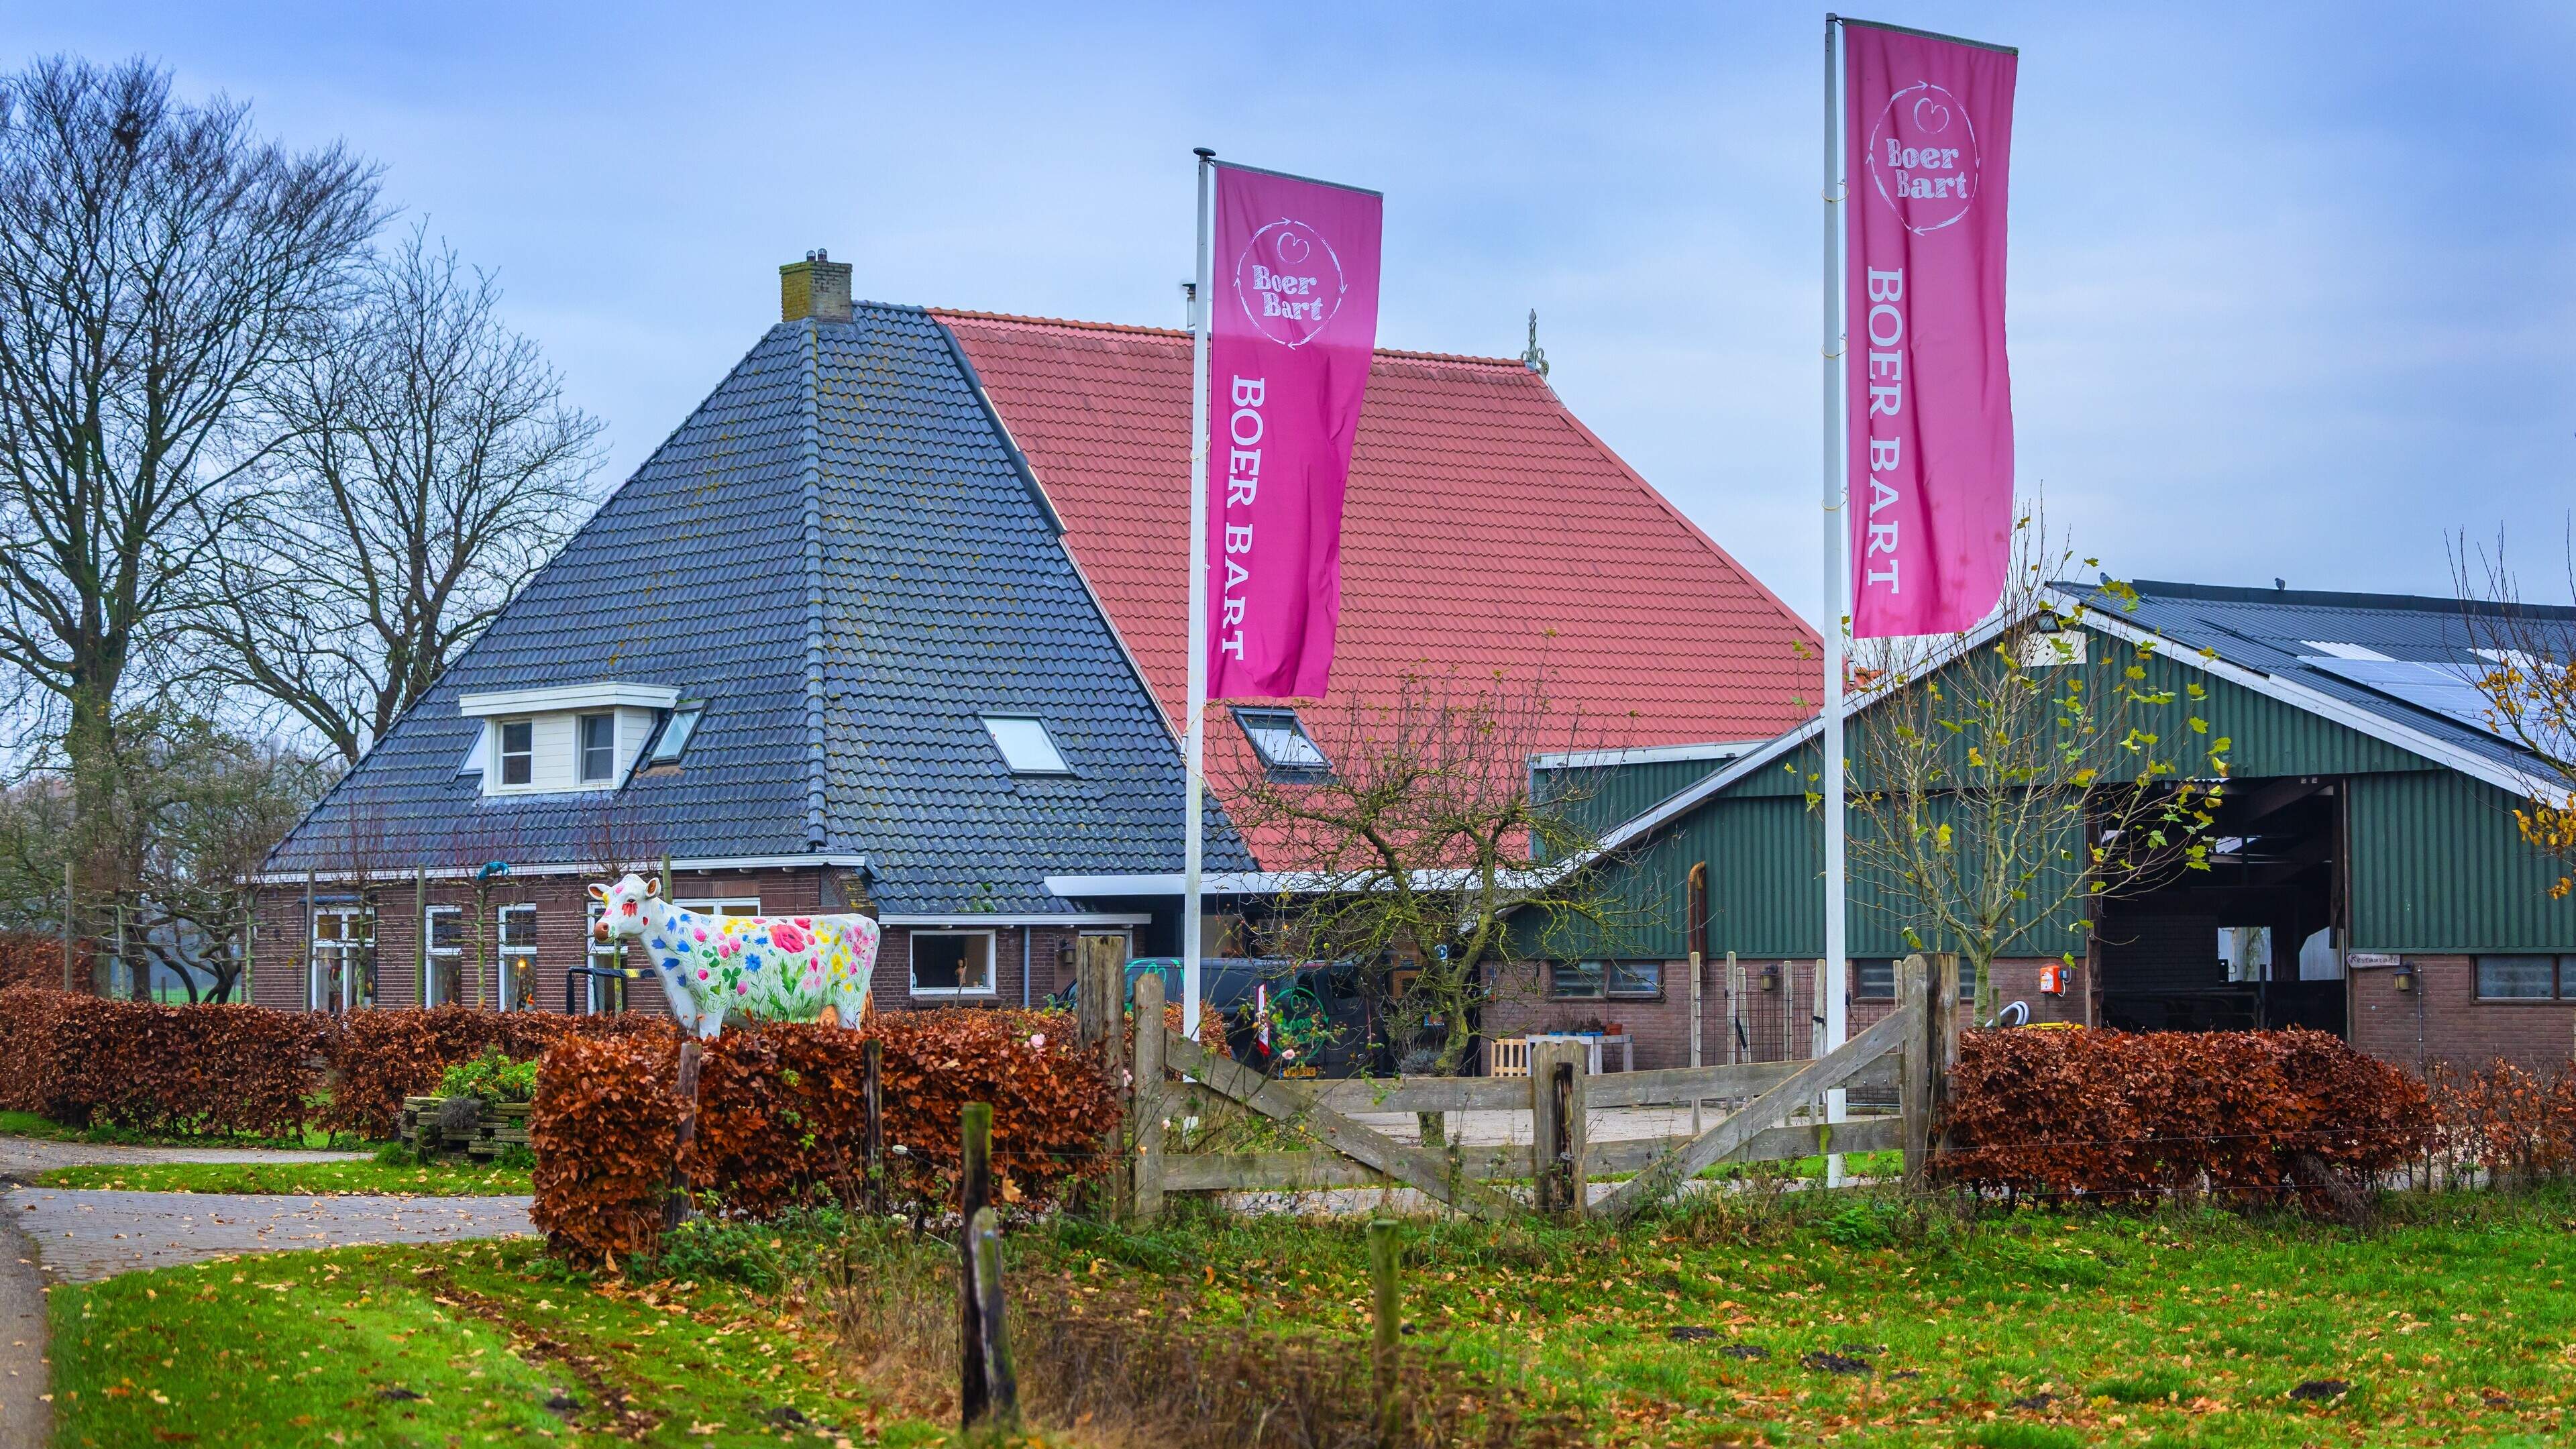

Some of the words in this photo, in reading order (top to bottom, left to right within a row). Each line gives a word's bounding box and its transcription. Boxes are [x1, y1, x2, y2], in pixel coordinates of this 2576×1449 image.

[1886, 138, 1959, 169] Boer
[1895, 169, 1968, 199] Bart
[1252, 265, 1317, 294] Boer
[1262, 292, 1324, 321] Bart
[1868, 266, 1903, 419] BOER
[1226, 374, 1265, 508] BOER
[1868, 435, 1900, 594] BART
[1222, 522, 1253, 661] BART
